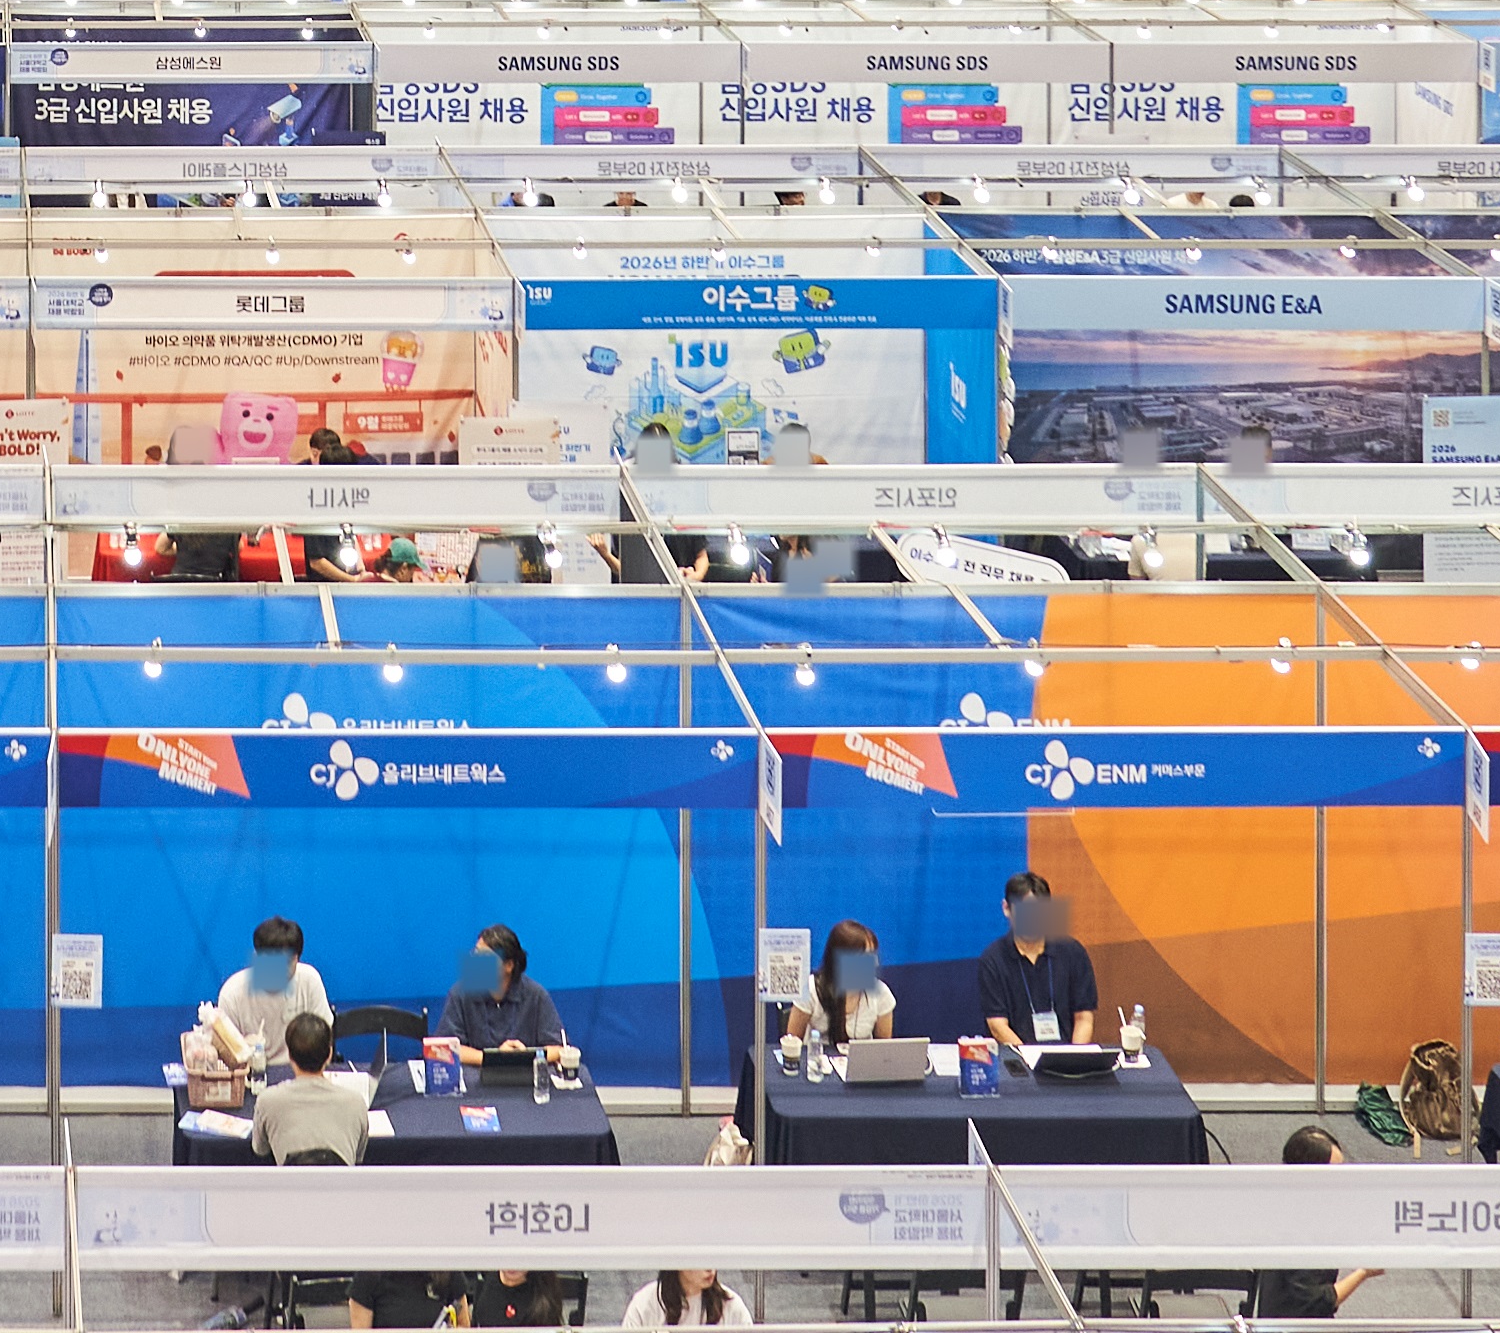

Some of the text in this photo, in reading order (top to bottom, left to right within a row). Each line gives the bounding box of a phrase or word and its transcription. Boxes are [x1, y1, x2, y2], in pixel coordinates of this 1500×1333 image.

[156, 57, 221, 70] 삼성에스원
[498, 56, 619, 71] SAMSUNG SDS
[35, 98, 213, 124] 3급 신입사원 채용
[703, 285, 799, 312] 이수그룹
[174, 355, 379, 367] #CDMO #QA/QC #Up/Downstream
[382, 763, 505, 784] 올리브네트웍스
[1097, 764, 1205, 783] ENM 커머스부문
